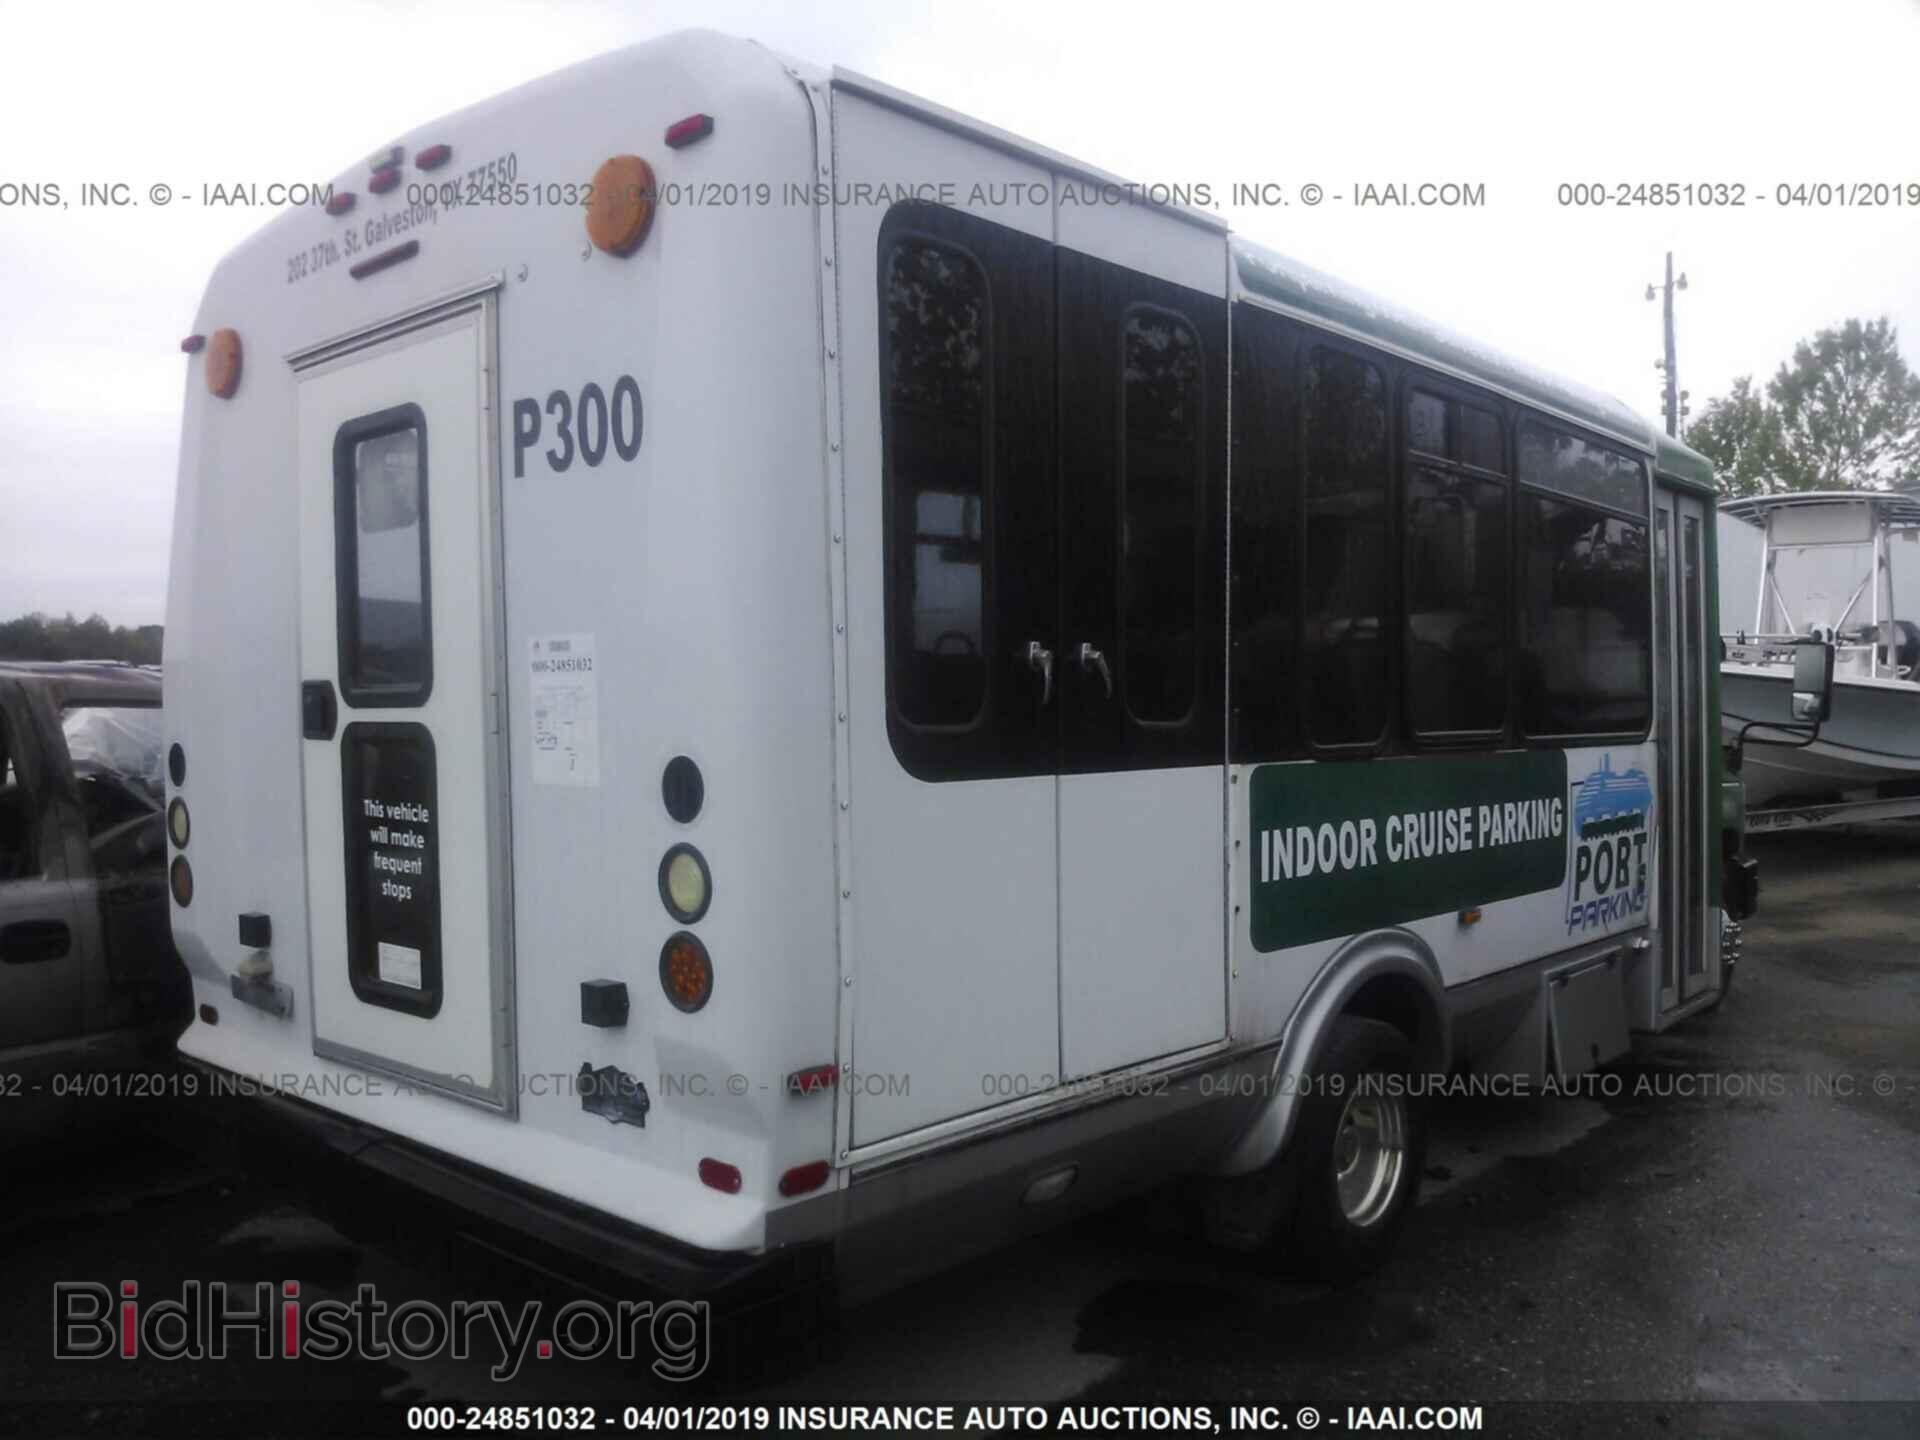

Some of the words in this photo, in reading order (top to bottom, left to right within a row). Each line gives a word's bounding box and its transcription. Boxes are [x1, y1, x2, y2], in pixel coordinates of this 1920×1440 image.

[468, 152, 517, 198] 77550
[513, 374, 643, 478] P300
[364, 800, 385, 819] This
[387, 803, 430, 823] vehicle
[370, 826, 388, 845] will
[391, 830, 425, 849] make
[1260, 817, 1378, 882] INDOOR
[1386, 806, 1473, 863] CRUISE
[1478, 797, 1563, 849] PARKING
[374, 851, 422, 875] frequent
[1574, 832, 1648, 901] PORT
[382, 880, 412, 901] stops
[1567, 886, 1648, 936] PARKING
